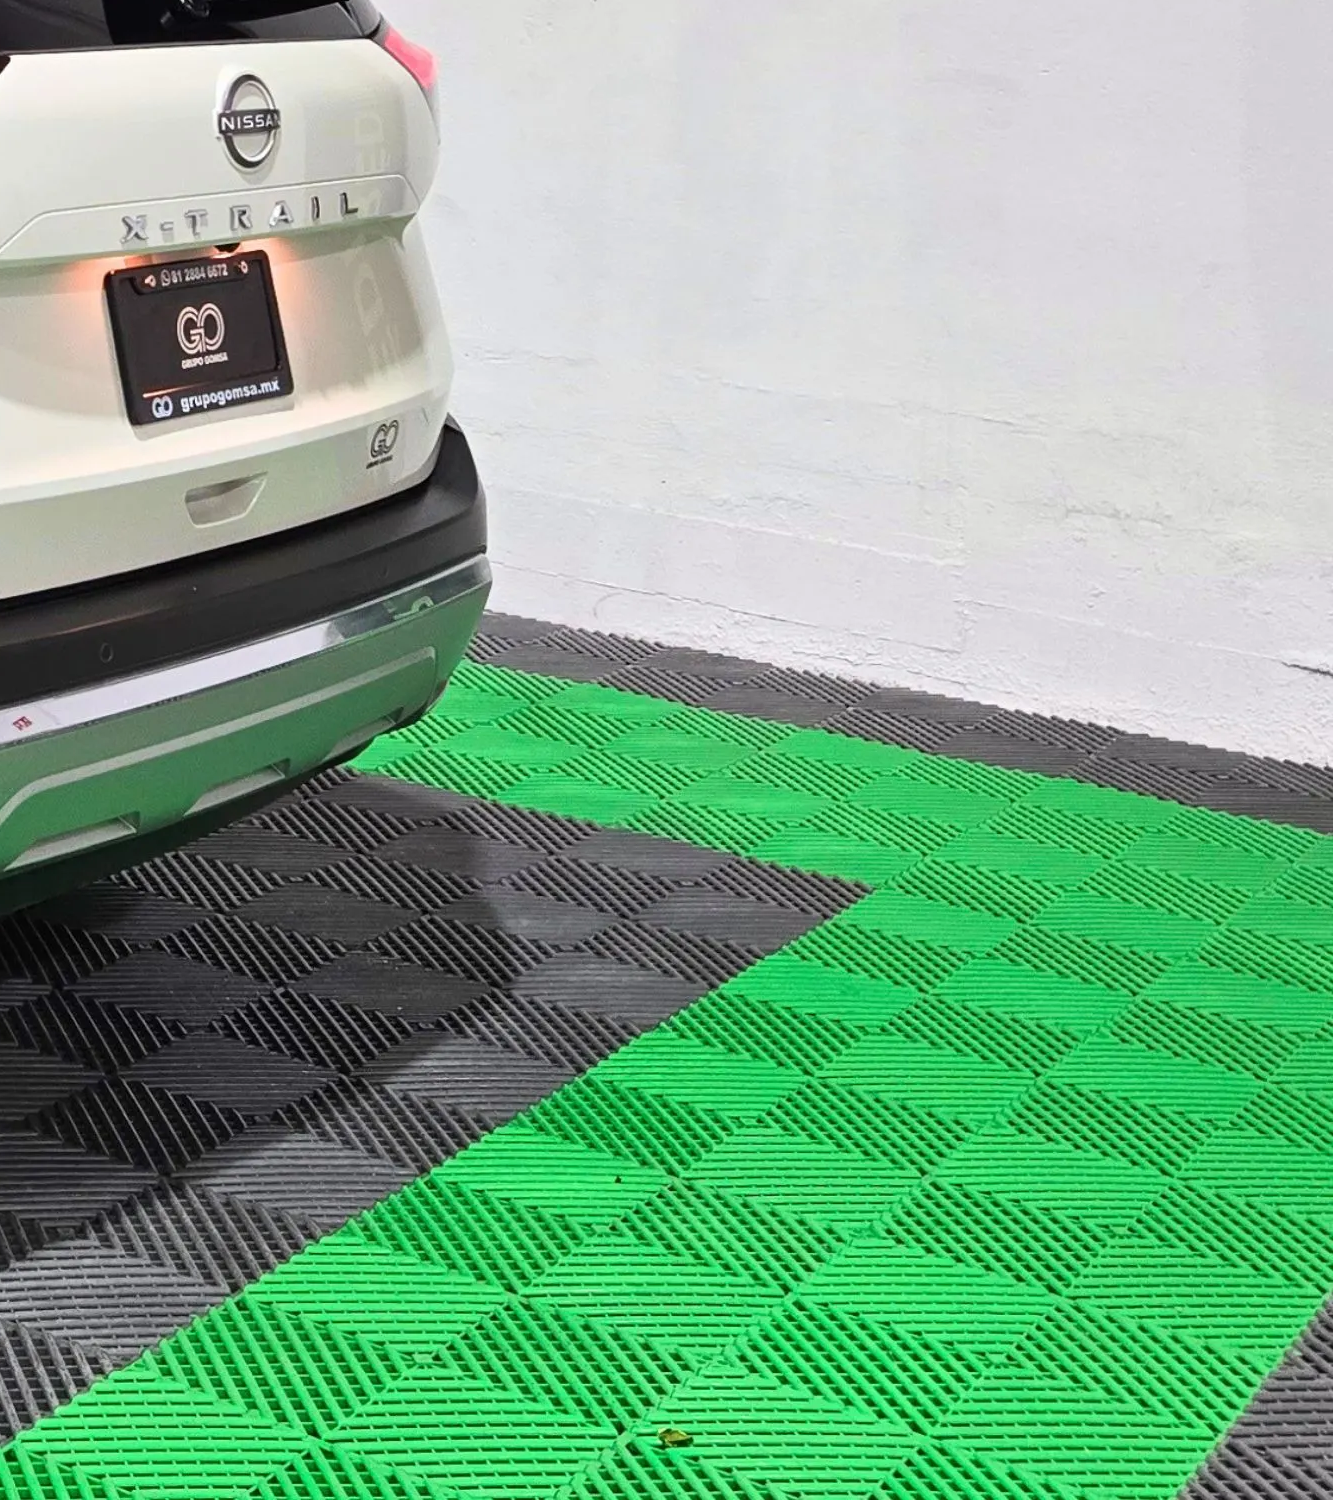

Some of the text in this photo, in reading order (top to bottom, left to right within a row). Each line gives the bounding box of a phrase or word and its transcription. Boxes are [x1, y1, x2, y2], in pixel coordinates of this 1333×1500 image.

[220, 113, 281, 131] NISSAN
[120, 192, 359, 244] X-TRAIL
[180, 380, 280, 412] grupogomsa.mx
